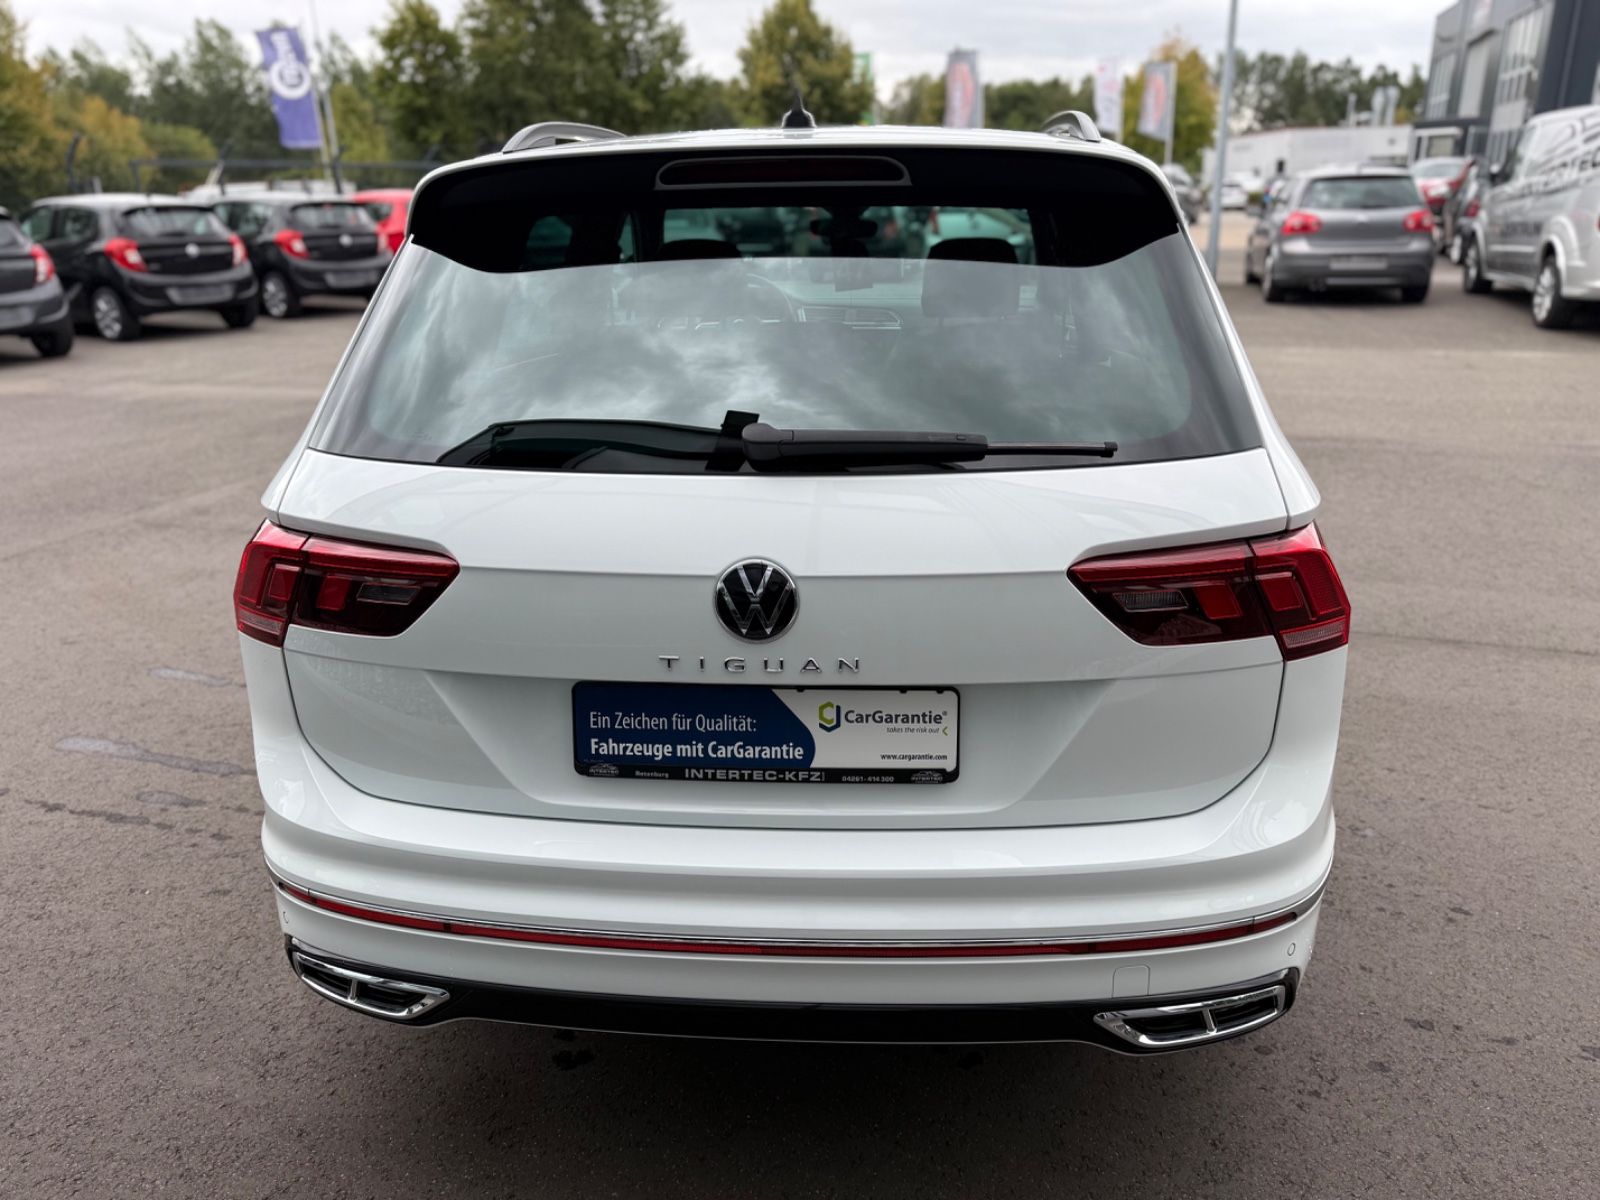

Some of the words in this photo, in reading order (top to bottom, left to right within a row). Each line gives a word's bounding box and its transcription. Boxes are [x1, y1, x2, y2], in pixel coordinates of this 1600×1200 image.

[658, 655, 860, 673] TIGUAN
[589, 711, 611, 729] Ein
[614, 712, 668, 730] Zeichen
[671, 713, 692, 731] für
[695, 714, 757, 733] Qualität:
[886, 726, 903, 734] takes
[904, 726, 915, 734] the
[916, 726, 927, 734] risk
[590, 738, 672, 761] Fahrzeuge
[676, 740, 704, 758] mit
[707, 741, 804, 760] CarGarantie
[880, 753, 948, 762] www.cargarantie.com
[684, 768, 821, 781] INTERTEC-KFZ
